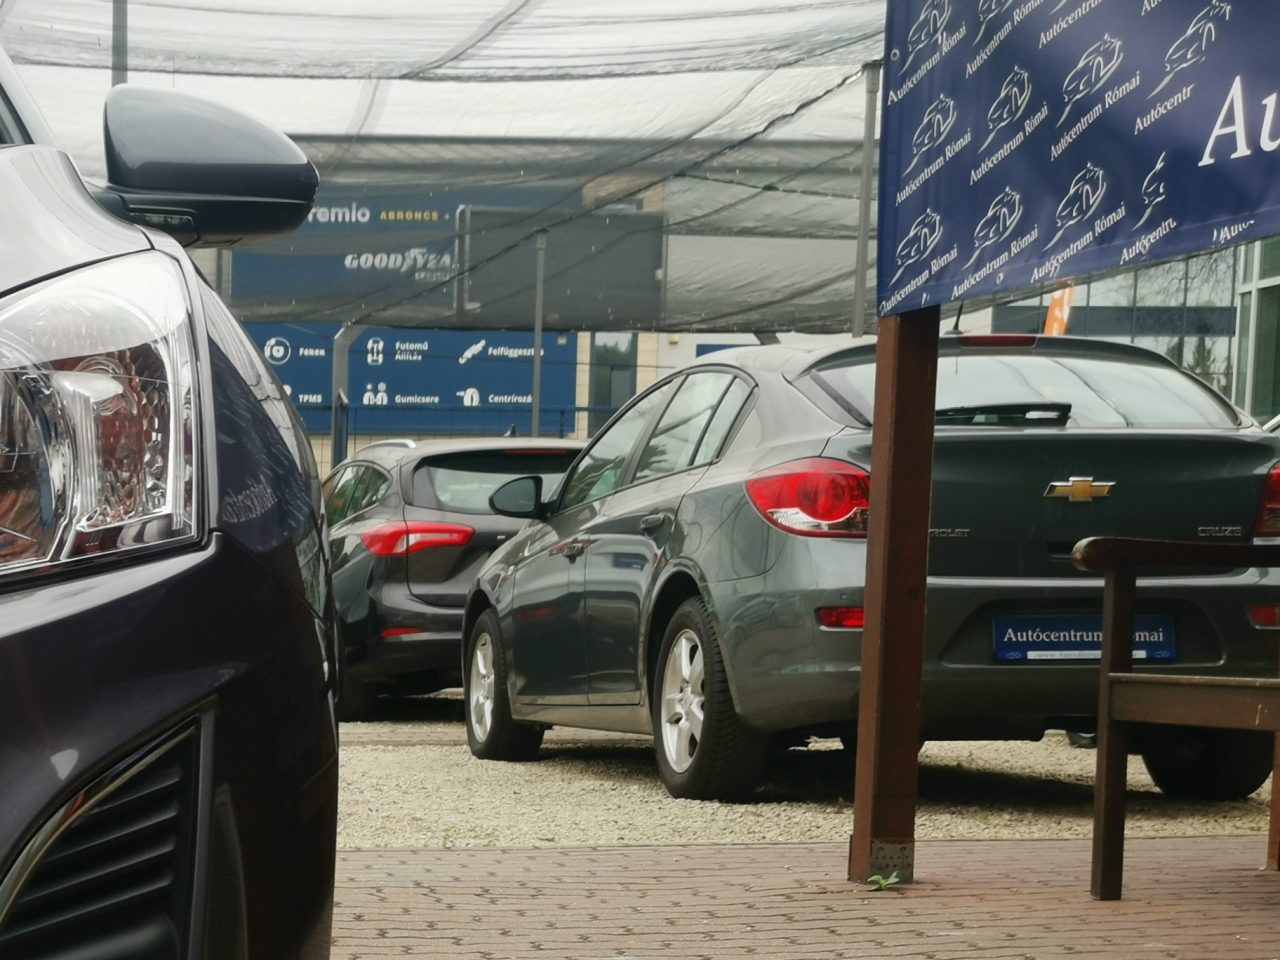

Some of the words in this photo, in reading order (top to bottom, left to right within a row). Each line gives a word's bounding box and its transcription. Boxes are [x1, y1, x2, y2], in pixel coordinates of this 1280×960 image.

[965, 22, 1012, 78] Autócentrum
[1013, 0, 1044, 26] Róma
[1039, 0, 1104, 49] Autócentru
[887, 52, 941, 105] Autócentrum
[1050, 106, 1103, 162] Autócentrum
[1104, 70, 1141, 109] Római
[895, 155, 945, 206] Autócentrum
[945, 128, 971, 162] Római
[970, 131, 1024, 186] Autócentrum
[1024, 101, 1048, 137] Római
[308, 202, 371, 223] remio
[344, 248, 459, 272] GOODYEA
[951, 253, 1009, 300] Autócentrum
[1010, 224, 1039, 256] Római
[1030, 230, 1093, 283] Autócentrum
[1094, 202, 1126, 237] Római
[880, 272, 929, 316] Autócentrum
[930, 244, 958, 273] Római
[488, 346, 544, 358] Felfüggeszts
[298, 394, 322, 403] TPMS
[395, 394, 439, 404] Gumicsere
[488, 393, 533, 404] Centrírozá
[1198, 526, 1242, 537] CRUZE
[1133, 628, 1164, 642] mai
